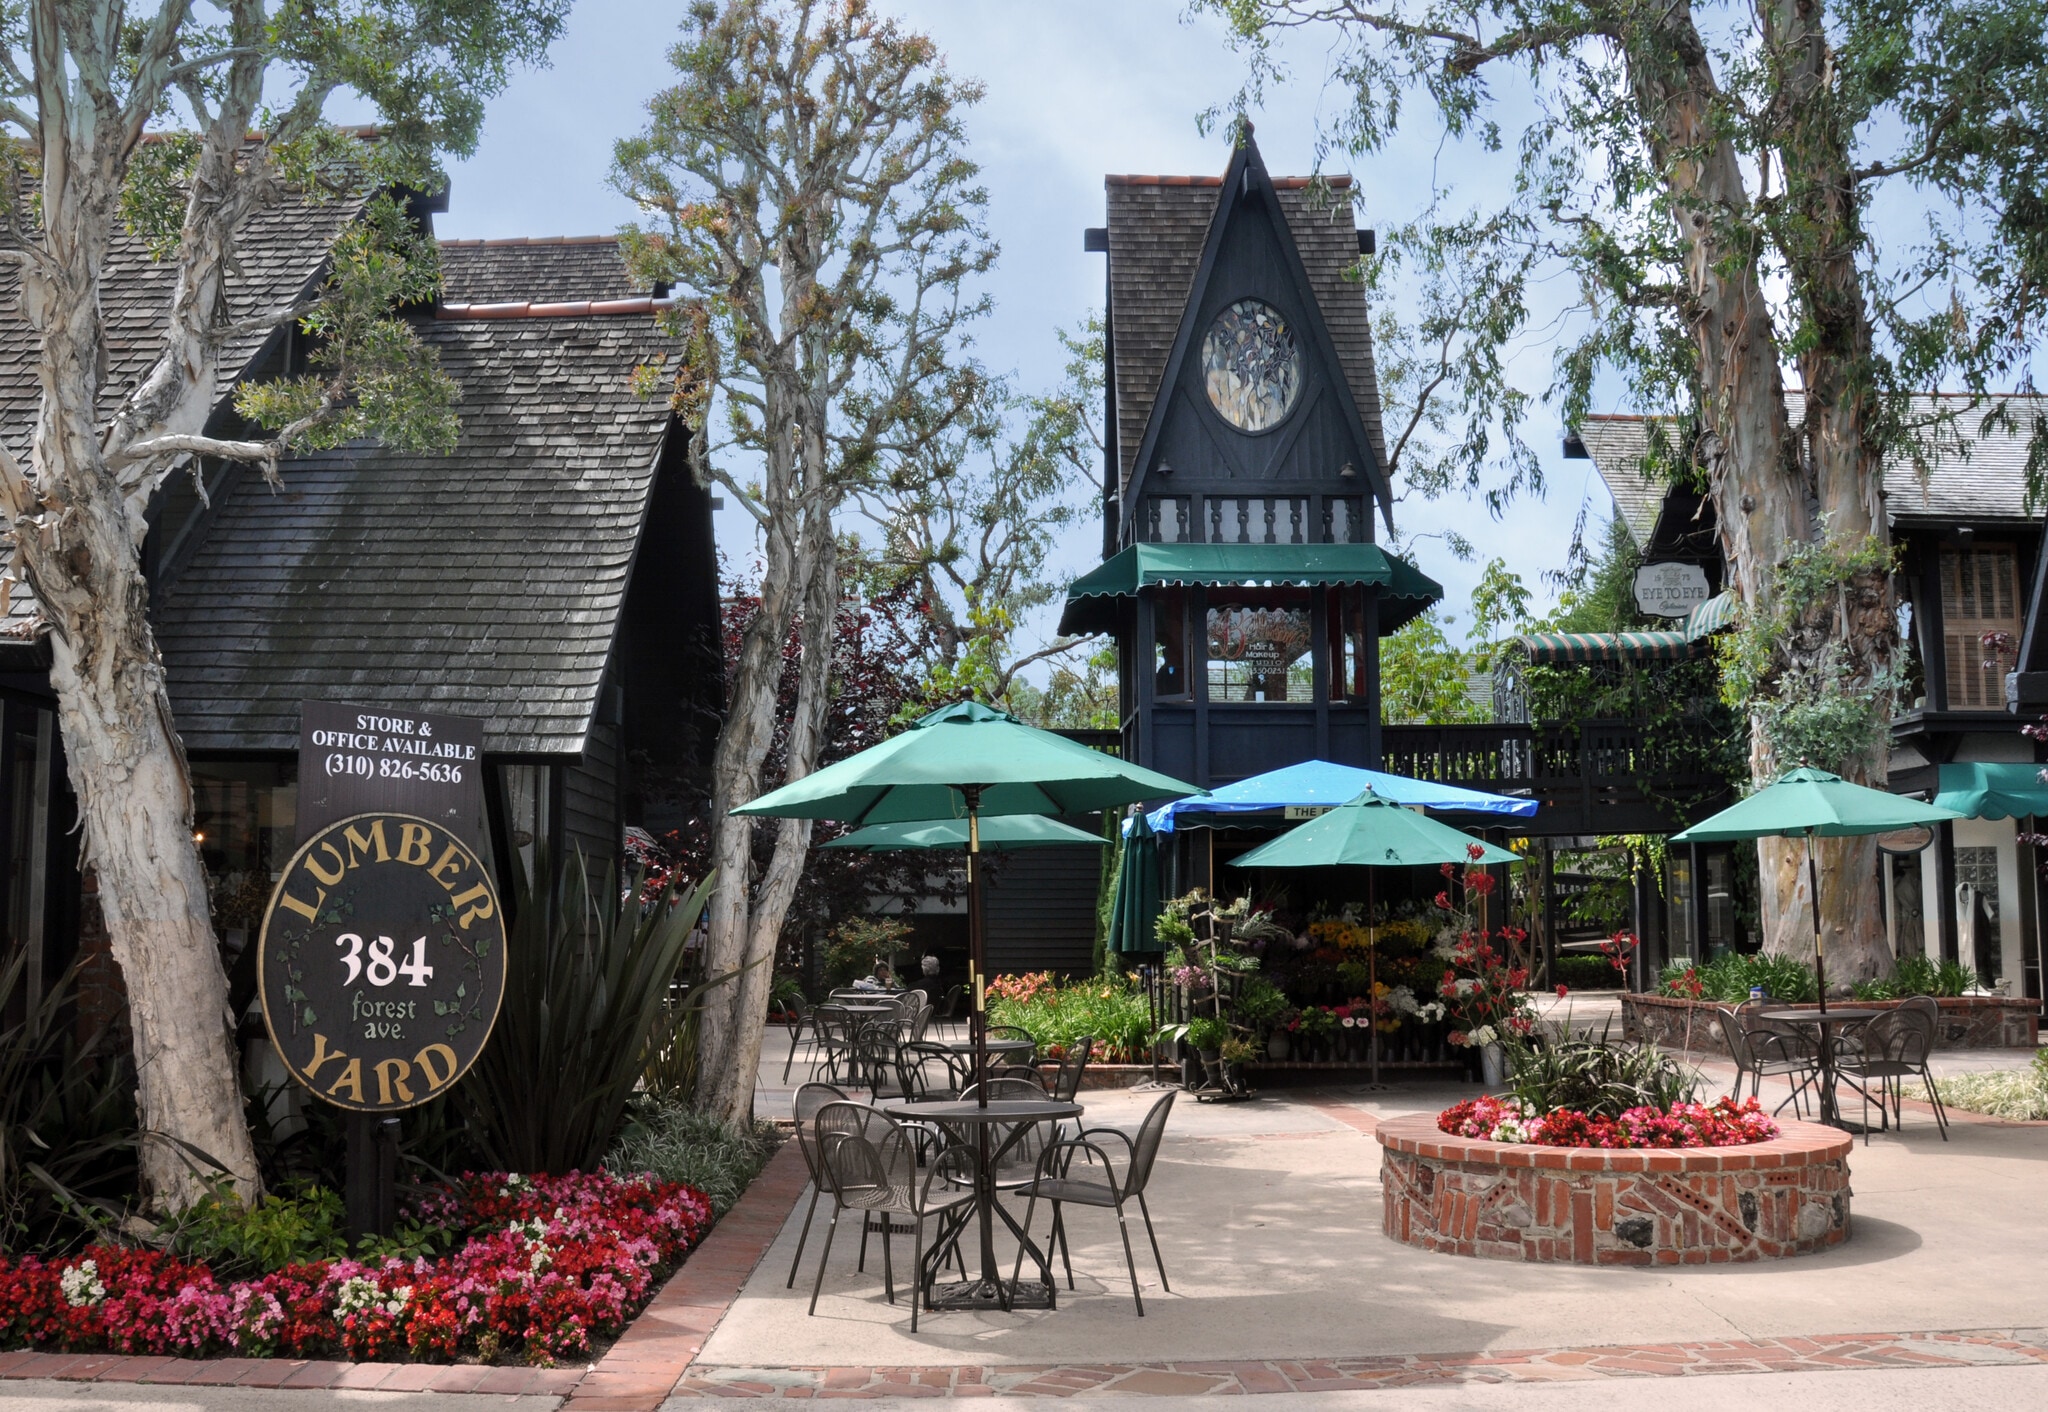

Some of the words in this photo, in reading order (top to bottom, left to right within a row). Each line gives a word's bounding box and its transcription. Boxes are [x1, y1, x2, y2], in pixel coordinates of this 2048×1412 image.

[1642, 587, 1662, 599] EYE
[1665, 587, 1681, 599] TO
[1682, 587, 1704, 599] EYE
[1248, 643, 1268, 651] Hair
[1268, 643, 1275, 651] &
[356, 714, 414, 735] STORE
[418, 721, 433, 737] &
[312, 729, 379, 751] OFFICE
[381, 737, 476, 760] AVAILABLE
[325, 753, 374, 780] (310)
[379, 758, 462, 783] 826-5636
[1294, 807, 1317, 817] THE
[279, 819, 494, 930] LUMBER
[335, 933, 433, 987] 384
[352, 990, 416, 1022] forest
[364, 1021, 406, 1040] ave.
[301, 1033, 458, 1105] YARD
